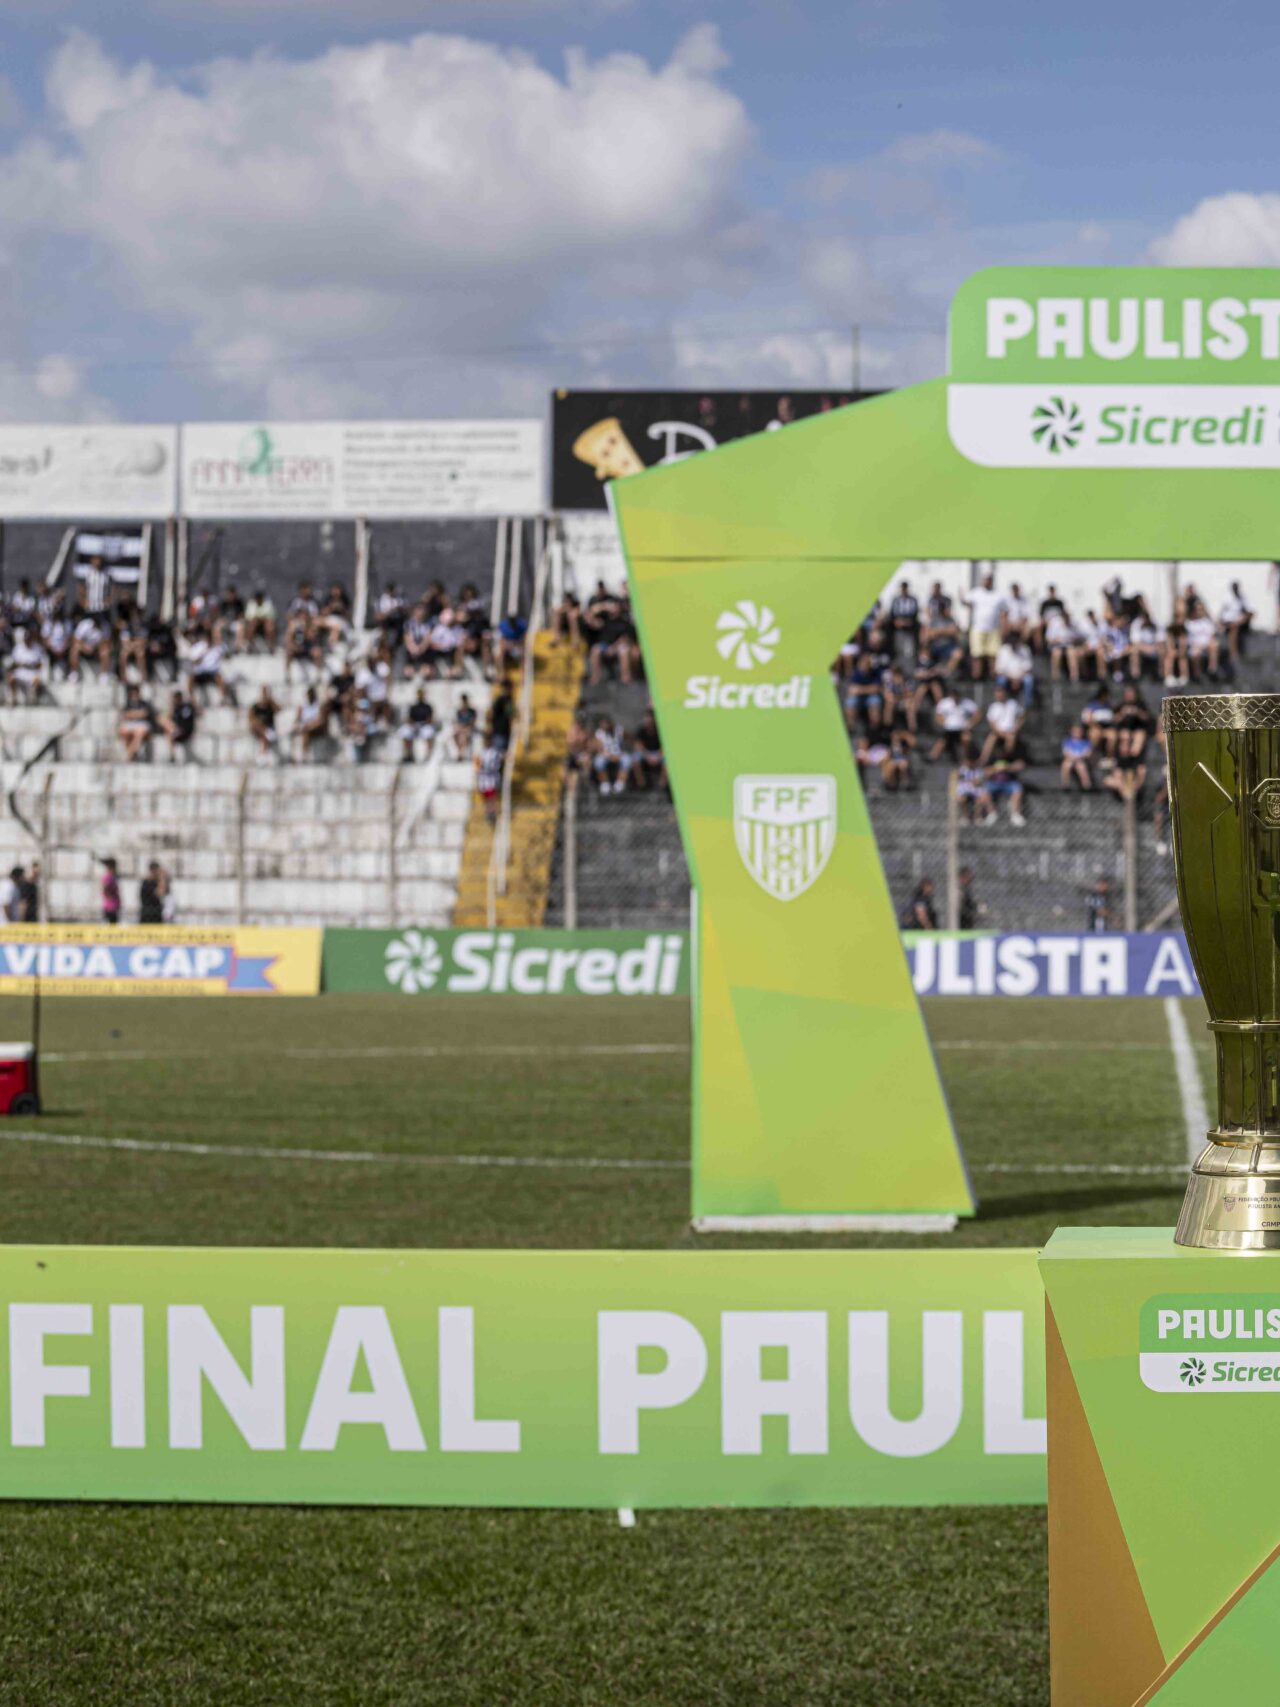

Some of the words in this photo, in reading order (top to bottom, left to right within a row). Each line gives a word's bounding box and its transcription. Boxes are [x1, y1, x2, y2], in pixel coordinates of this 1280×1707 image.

[1097, 405, 1267, 445] Sicredi
[684, 676, 810, 708] Sicredi
[753, 787, 816, 812] FPF
[4, 945, 117, 978] VIDA
[128, 946, 225, 979] CAP
[448, 932, 683, 995] Sicredi
[8, 1302, 520, 1452] FINAL
